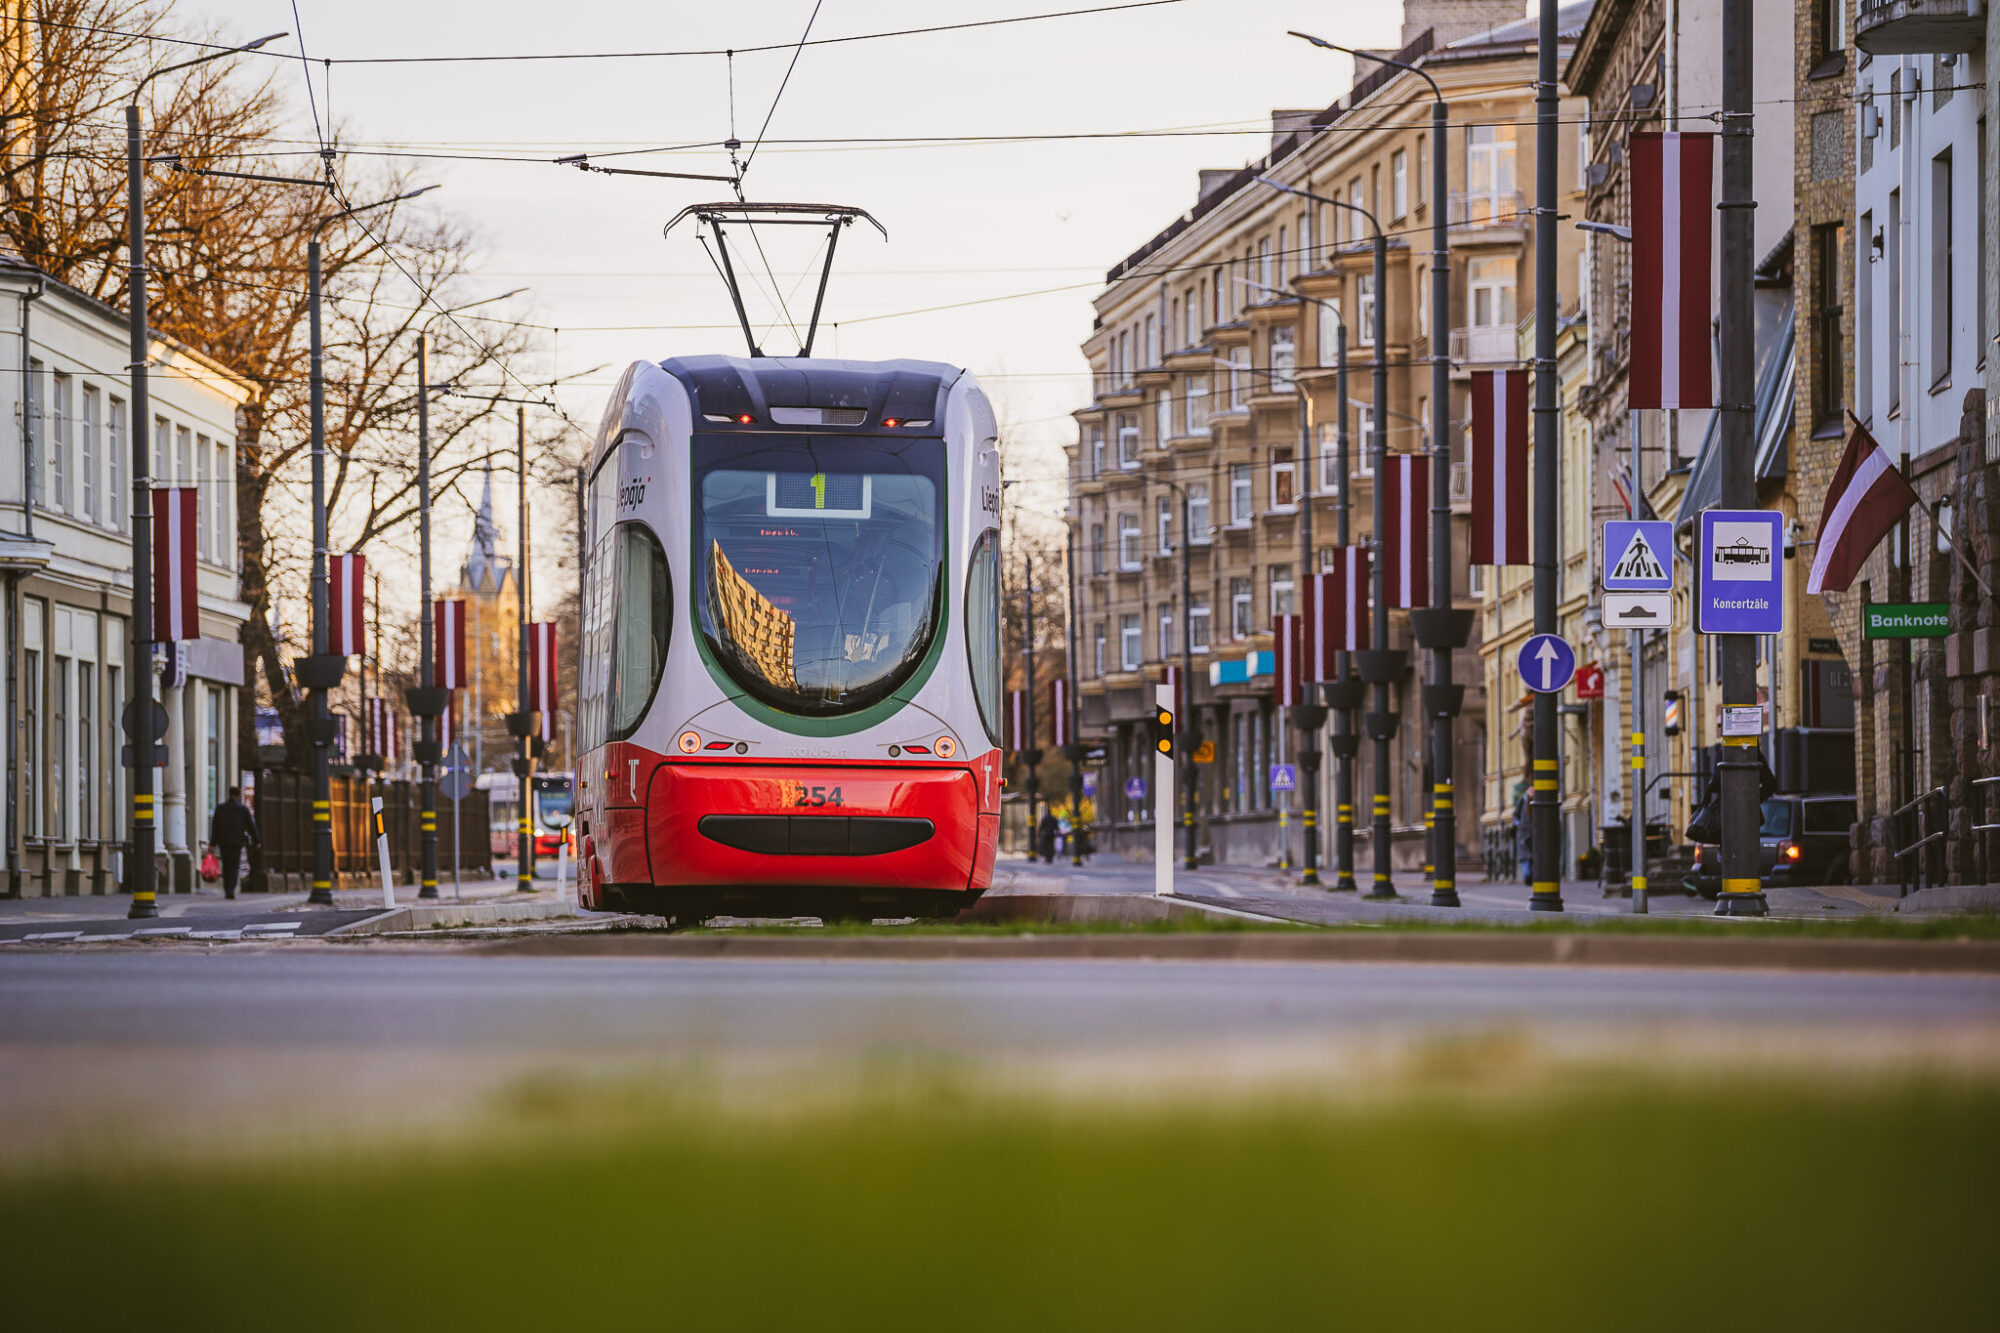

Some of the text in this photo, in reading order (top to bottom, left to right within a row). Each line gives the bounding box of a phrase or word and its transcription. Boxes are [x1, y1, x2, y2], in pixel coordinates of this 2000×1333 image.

[618, 477, 646, 512] iepāja
[809, 473, 825, 508] 1
[1713, 597, 1769, 609] Koncertzāle
[1870, 614, 1949, 627] Banknote
[794, 786, 844, 807] 254
